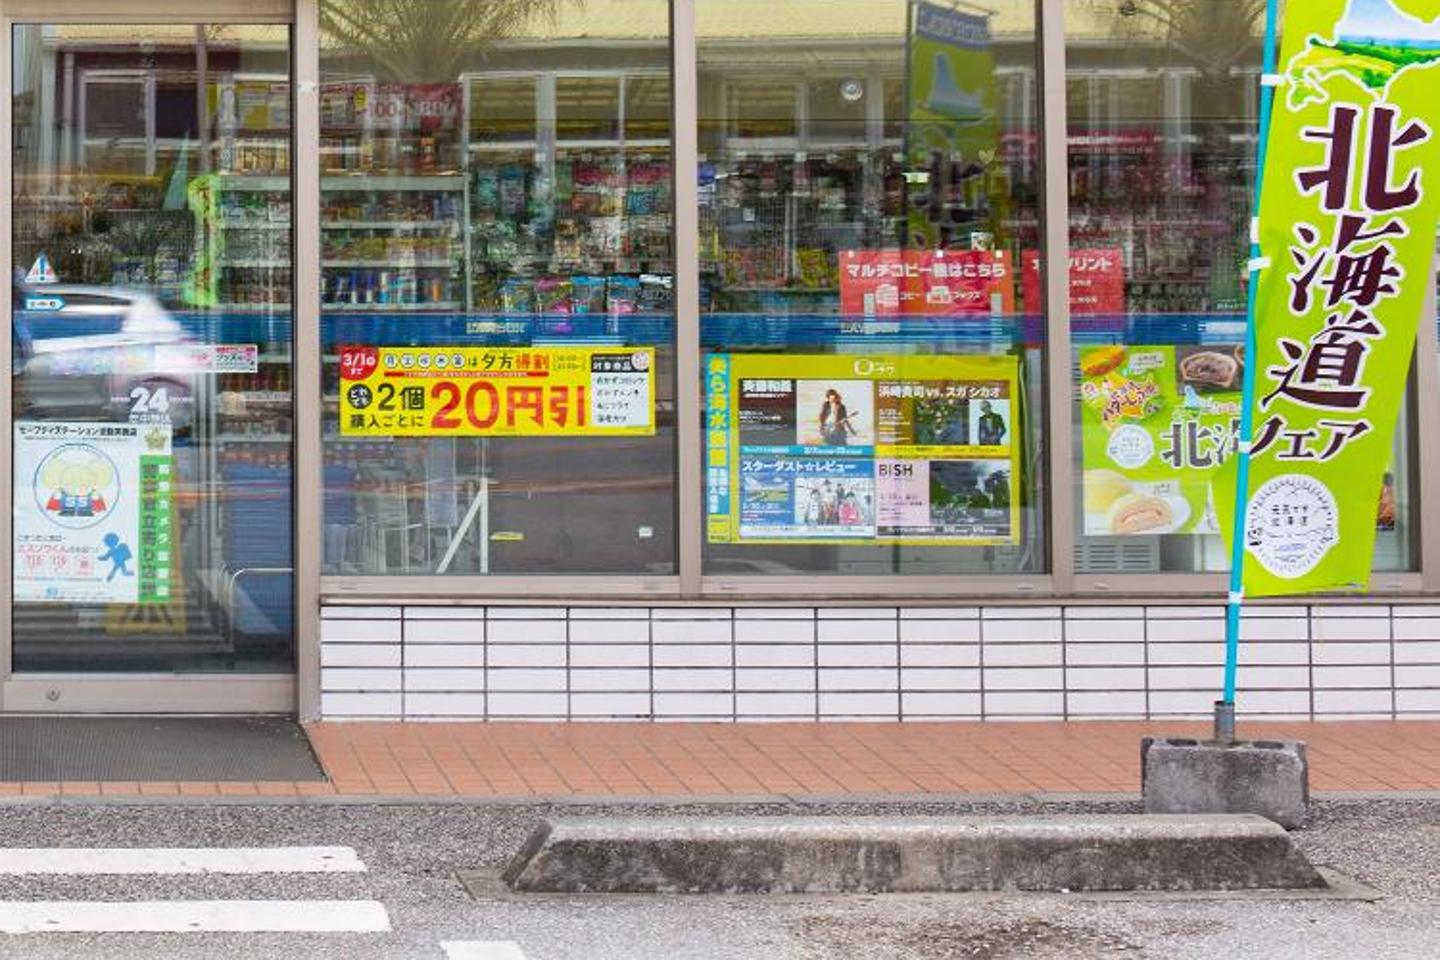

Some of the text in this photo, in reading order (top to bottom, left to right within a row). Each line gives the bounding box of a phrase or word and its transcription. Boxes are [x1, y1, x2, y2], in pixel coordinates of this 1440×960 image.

[1262, 106, 1428, 409] 北海道
[130, 387, 170, 414] 24
[431, 381, 585, 429] 20円引
